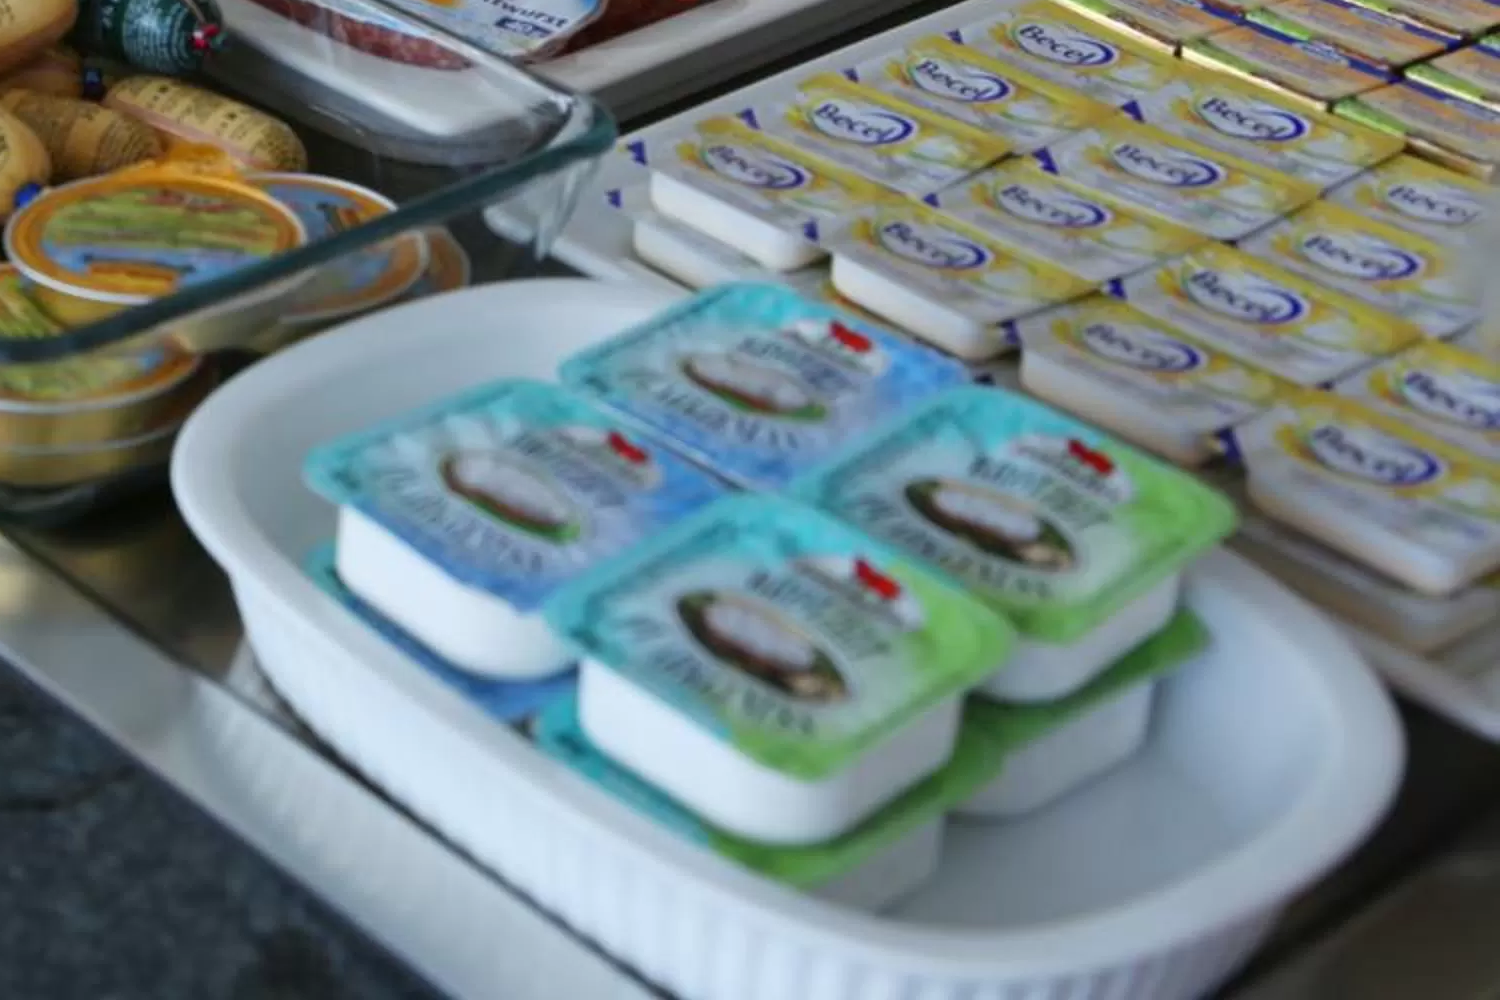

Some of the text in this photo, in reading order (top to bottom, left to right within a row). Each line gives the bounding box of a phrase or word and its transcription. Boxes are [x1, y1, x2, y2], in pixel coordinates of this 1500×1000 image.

[1019, 24, 1100, 66] Becel
[914, 60, 993, 101] Becel
[813, 102, 898, 145] Becel
[1201, 98, 1291, 141] Becel
[708, 144, 790, 188] Becel
[1114, 143, 1201, 187] Becel
[1002, 183, 1086, 227] Becel
[1389, 184, 1479, 225] Becel
[881, 221, 970, 268] Becel
[1304, 235, 1397, 278] Becel
[1191, 270, 1281, 323] Becel
[1084, 323, 1178, 372] Becel
[1312, 424, 1416, 485] Becel
